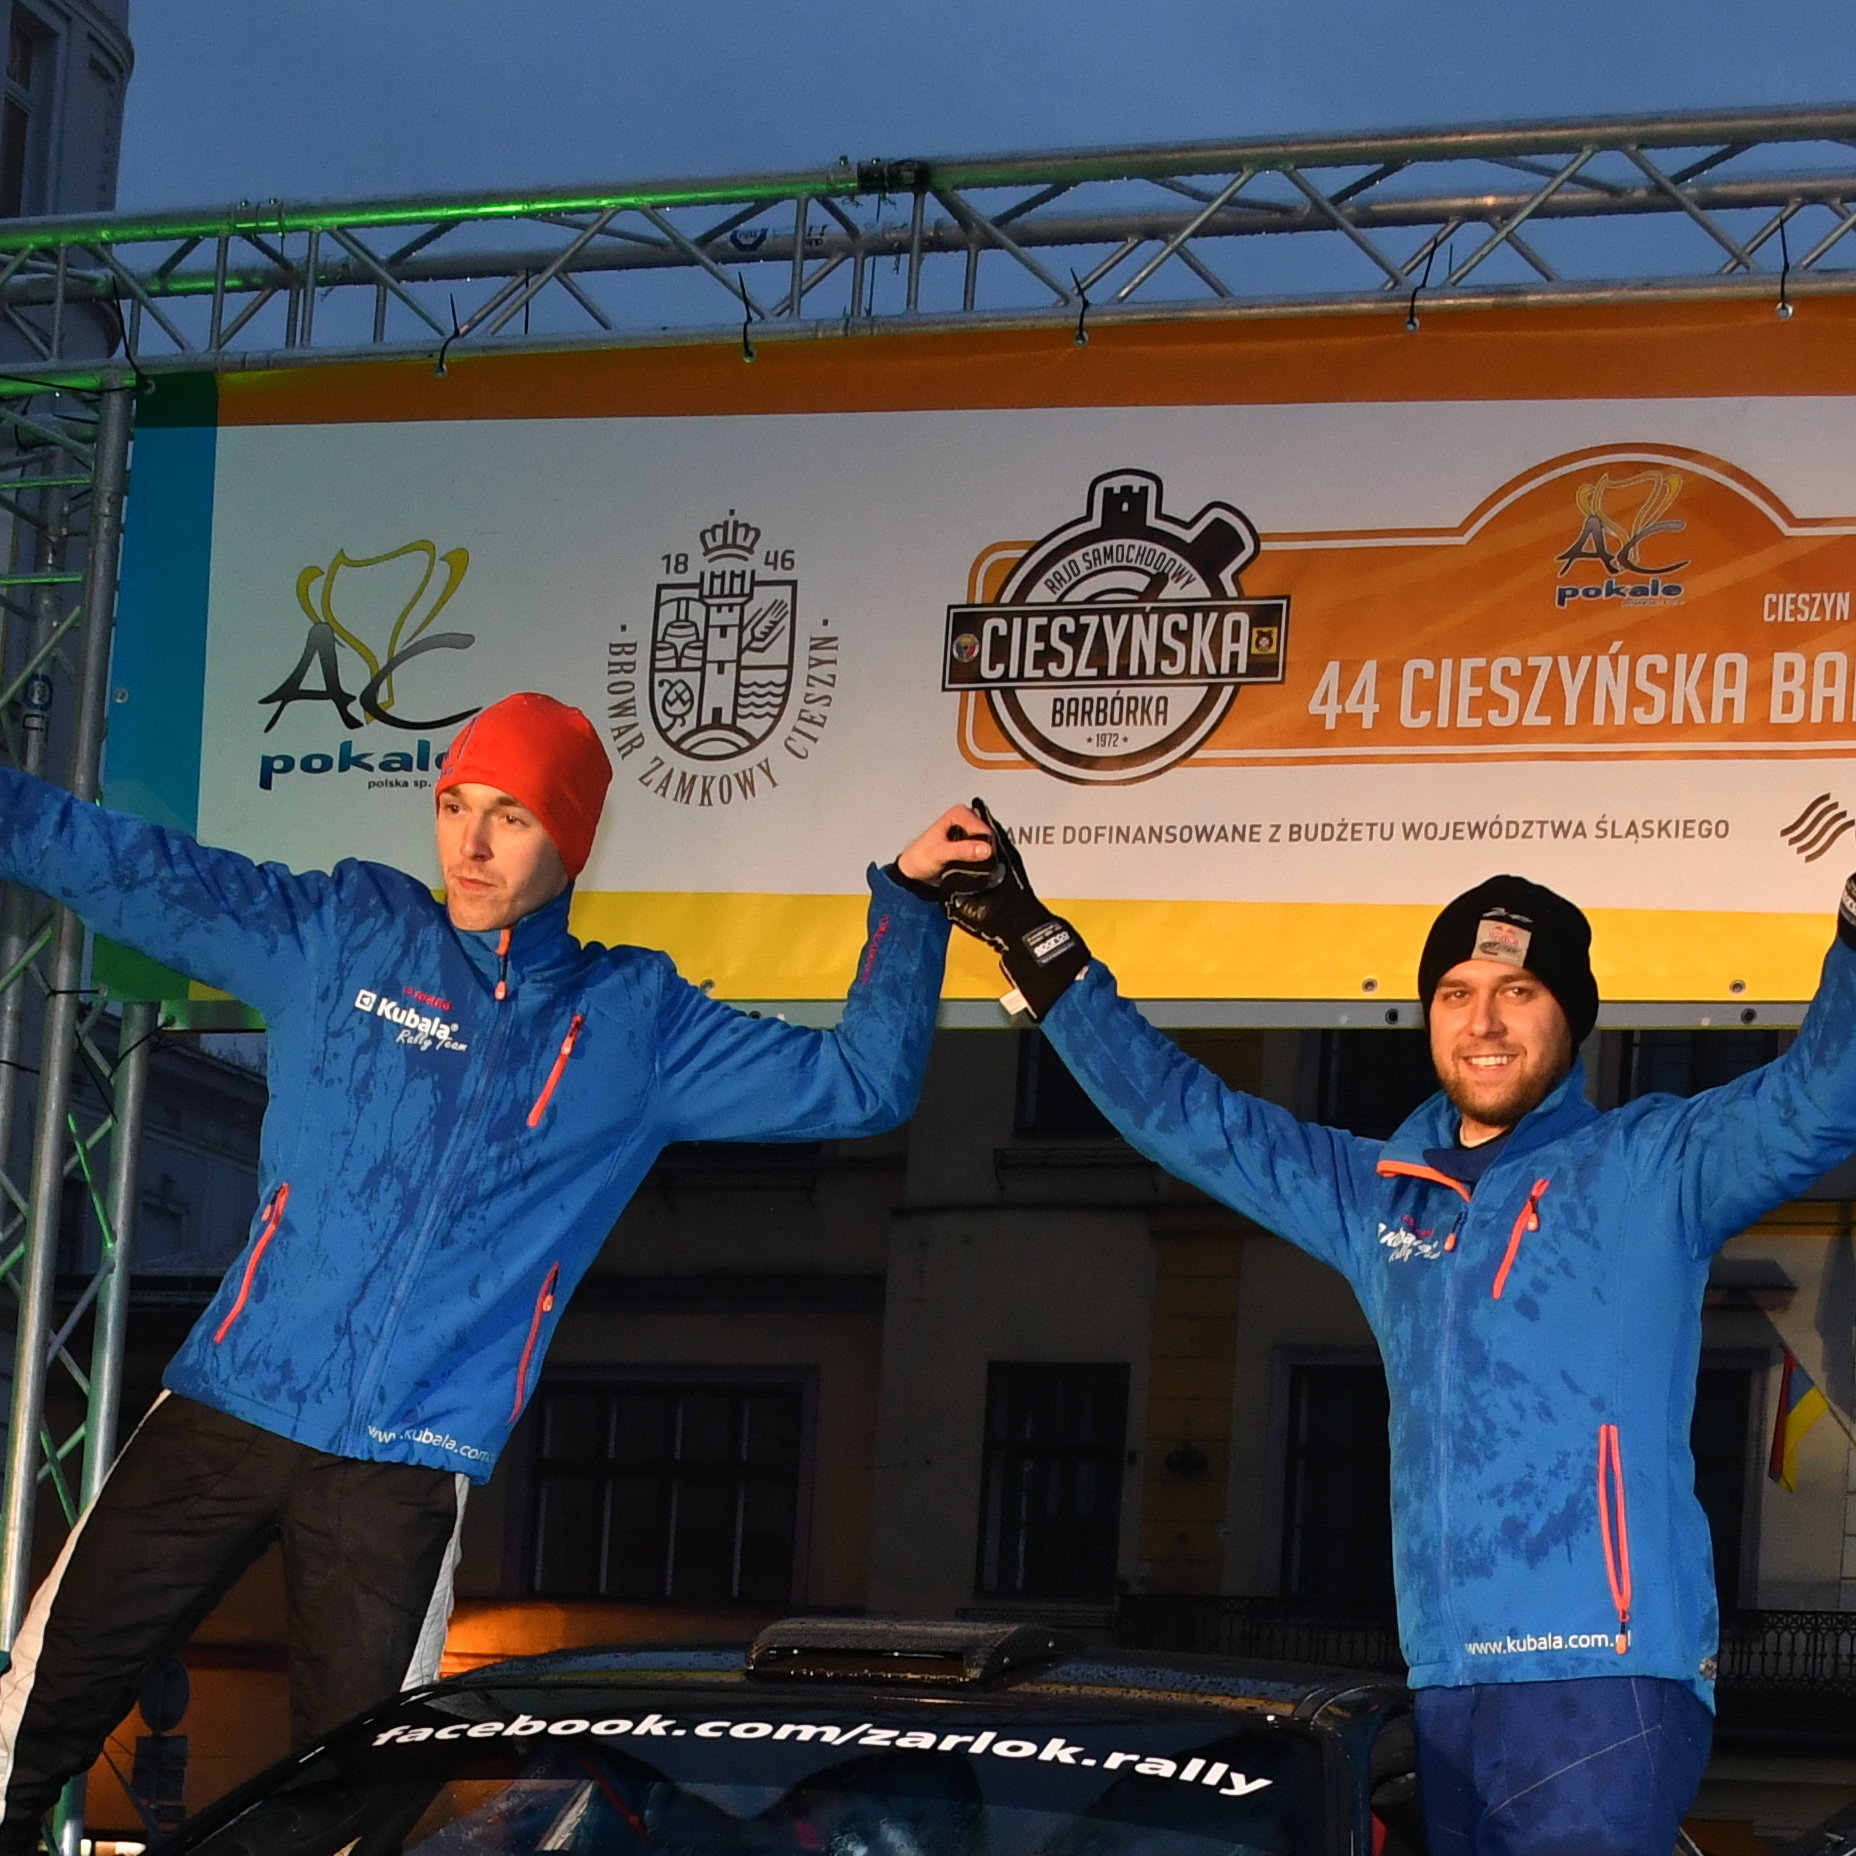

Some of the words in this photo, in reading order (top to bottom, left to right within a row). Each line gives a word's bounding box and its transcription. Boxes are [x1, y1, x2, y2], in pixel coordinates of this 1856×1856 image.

[661, 552, 689, 575] 18
[764, 549, 795, 571] 46
[1044, 559, 1081, 596] RAJD
[1082, 543, 1197, 591] SAMOCHODOWY
[1556, 577, 1685, 609] pokale
[1762, 591, 1849, 623] CIESZYN
[980, 605, 1249, 680] CIESZYŃSKA
[1308, 659, 1380, 730] 44
[1399, 639, 1748, 729] CIESZYŃSKA
[606, 640, 645, 760] BROWAR
[638, 755, 779, 807] ZAMKOWY
[784, 635, 840, 760] CIESZYN
[1051, 687, 1169, 728] BARBÓRKA
[1095, 731, 1120, 748] 1972
[367, 777, 409, 790] polska
[414, 779, 432, 790] sp.
[1006, 825, 1055, 845] ANIE
[1062, 822, 1262, 846] DOFINANSOWANE
[1268, 823, 1282, 844] Z
[1288, 817, 1395, 843] BUDŻETU
[1402, 814, 1588, 842] WOJEWÓDZTWA
[1594, 812, 1730, 845] ŚLĄSKIEGO
[376, 997, 452, 1041] Kubala
[370, 1711, 1274, 1798] facebook.com/zarlok.rally
